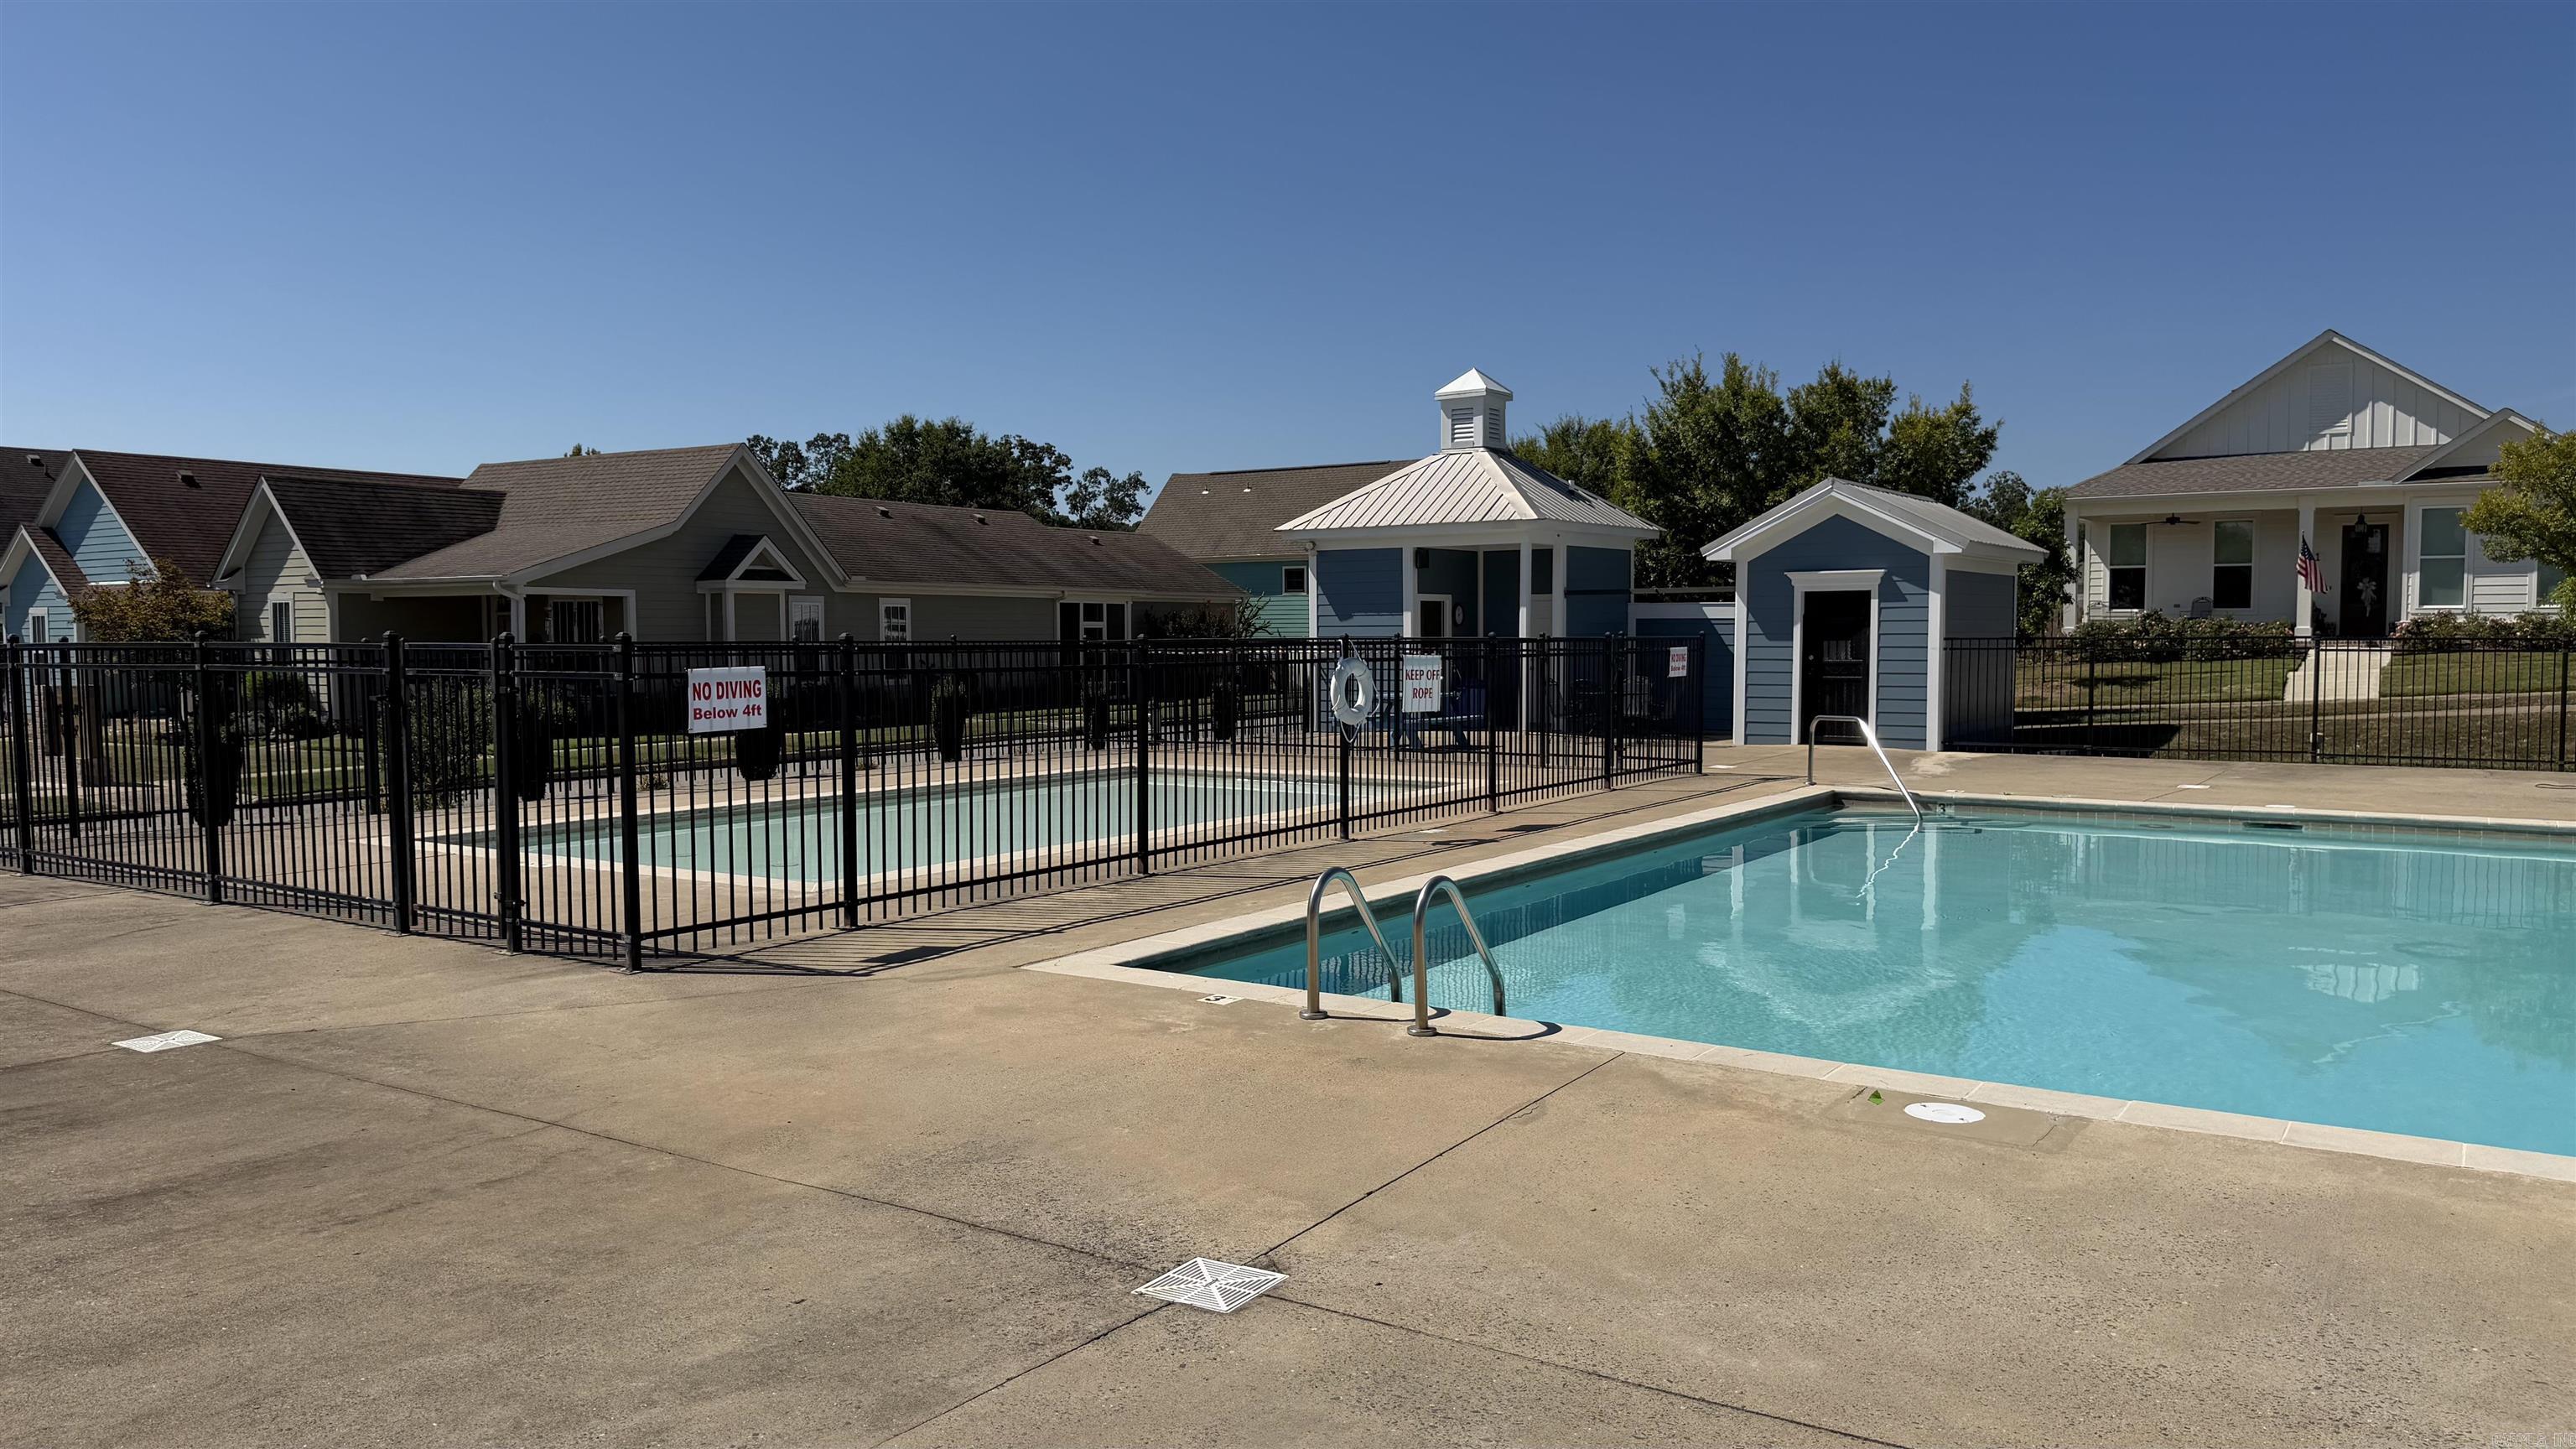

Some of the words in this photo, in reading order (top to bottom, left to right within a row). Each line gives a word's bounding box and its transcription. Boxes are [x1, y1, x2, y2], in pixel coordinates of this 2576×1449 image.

[1405, 669, 1424, 680] KEEP
[1426, 669, 1440, 680] OFF
[692, 682, 711, 701] NO
[716, 679, 761, 700] DIVING
[1412, 688, 1432, 699] ROPE
[693, 706, 738, 720] Below
[742, 704, 761, 716] 4ft
